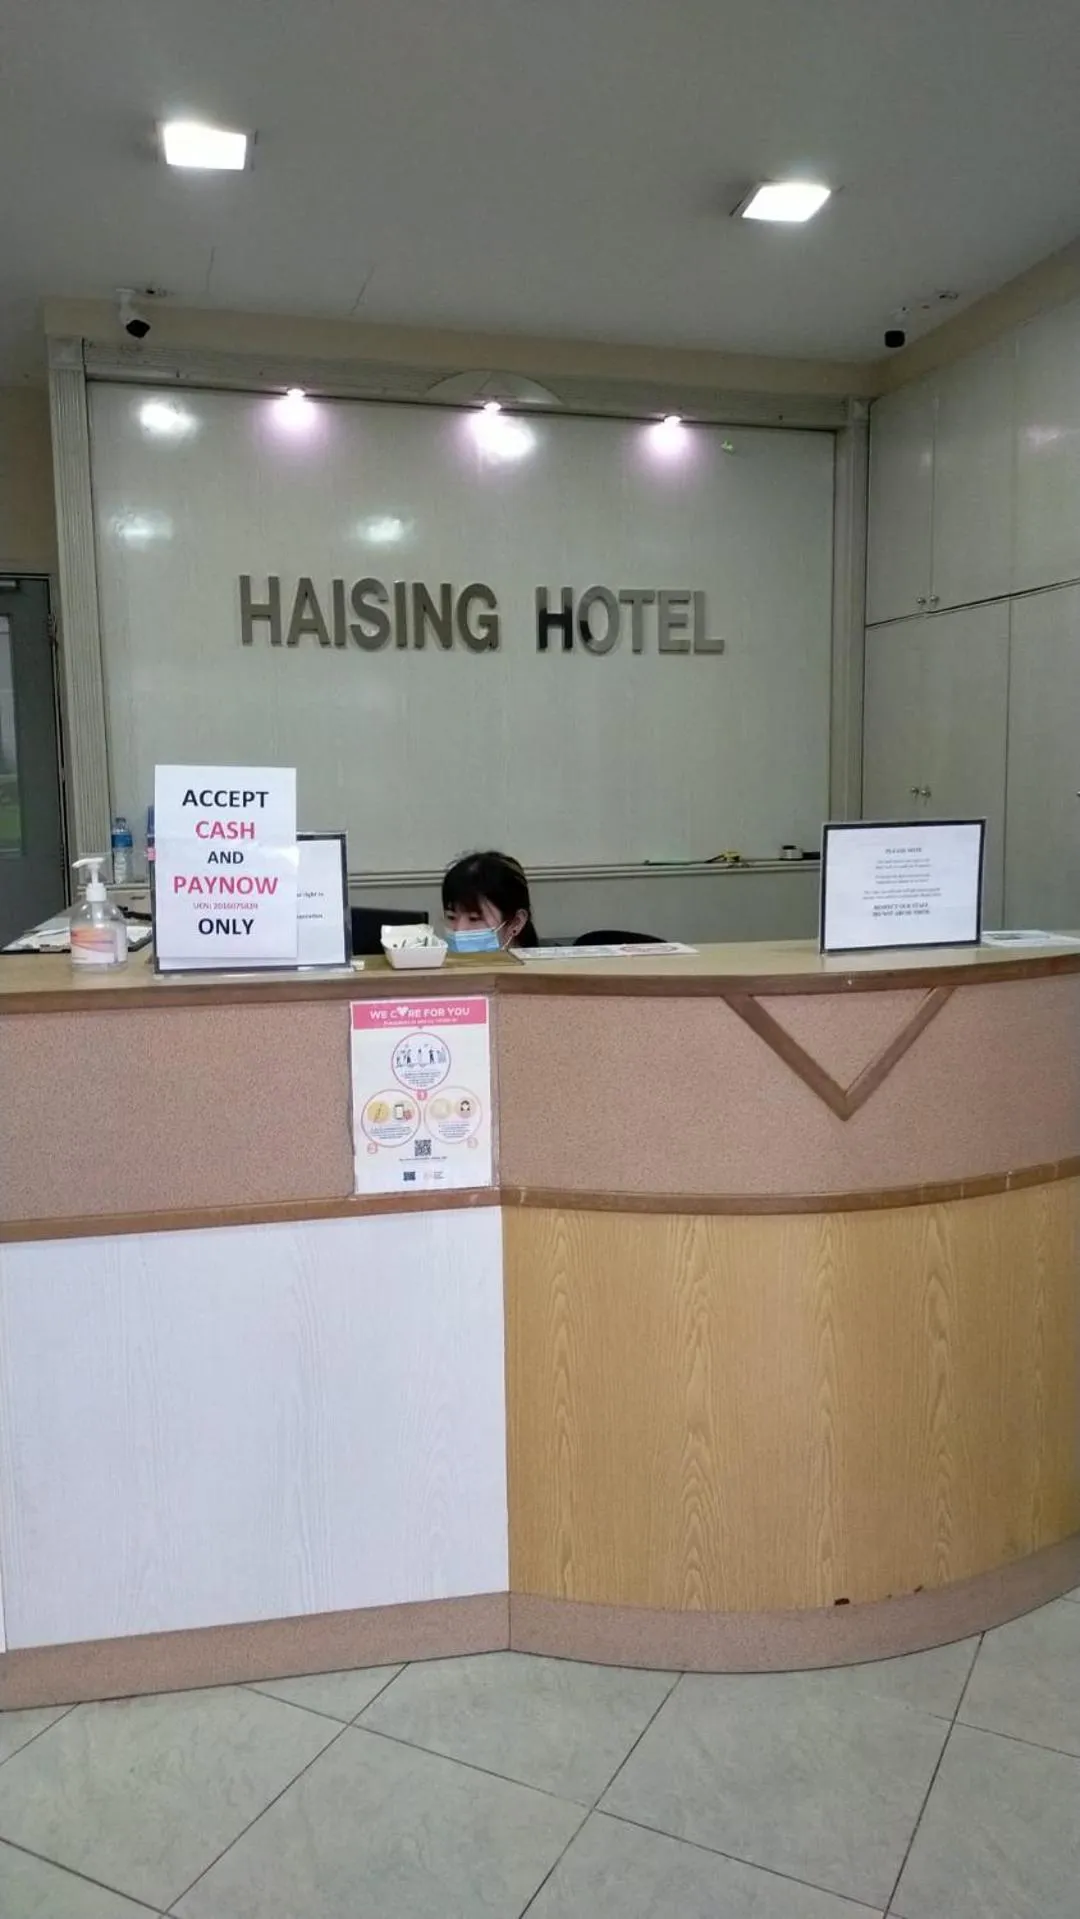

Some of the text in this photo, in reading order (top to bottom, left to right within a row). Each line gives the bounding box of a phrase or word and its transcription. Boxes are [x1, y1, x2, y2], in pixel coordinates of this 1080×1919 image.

[239, 574, 725, 655] HAISING HOTEL
[182, 789, 269, 808] ACCEPT
[195, 820, 255, 839] CASH
[207, 851, 244, 864] AND
[173, 876, 278, 895] PAYNOW
[198, 918, 255, 935] ONLY
[370, 1010, 387, 1020] WE
[424, 1009, 445, 1017] FOR
[447, 1007, 470, 1016] YOU
